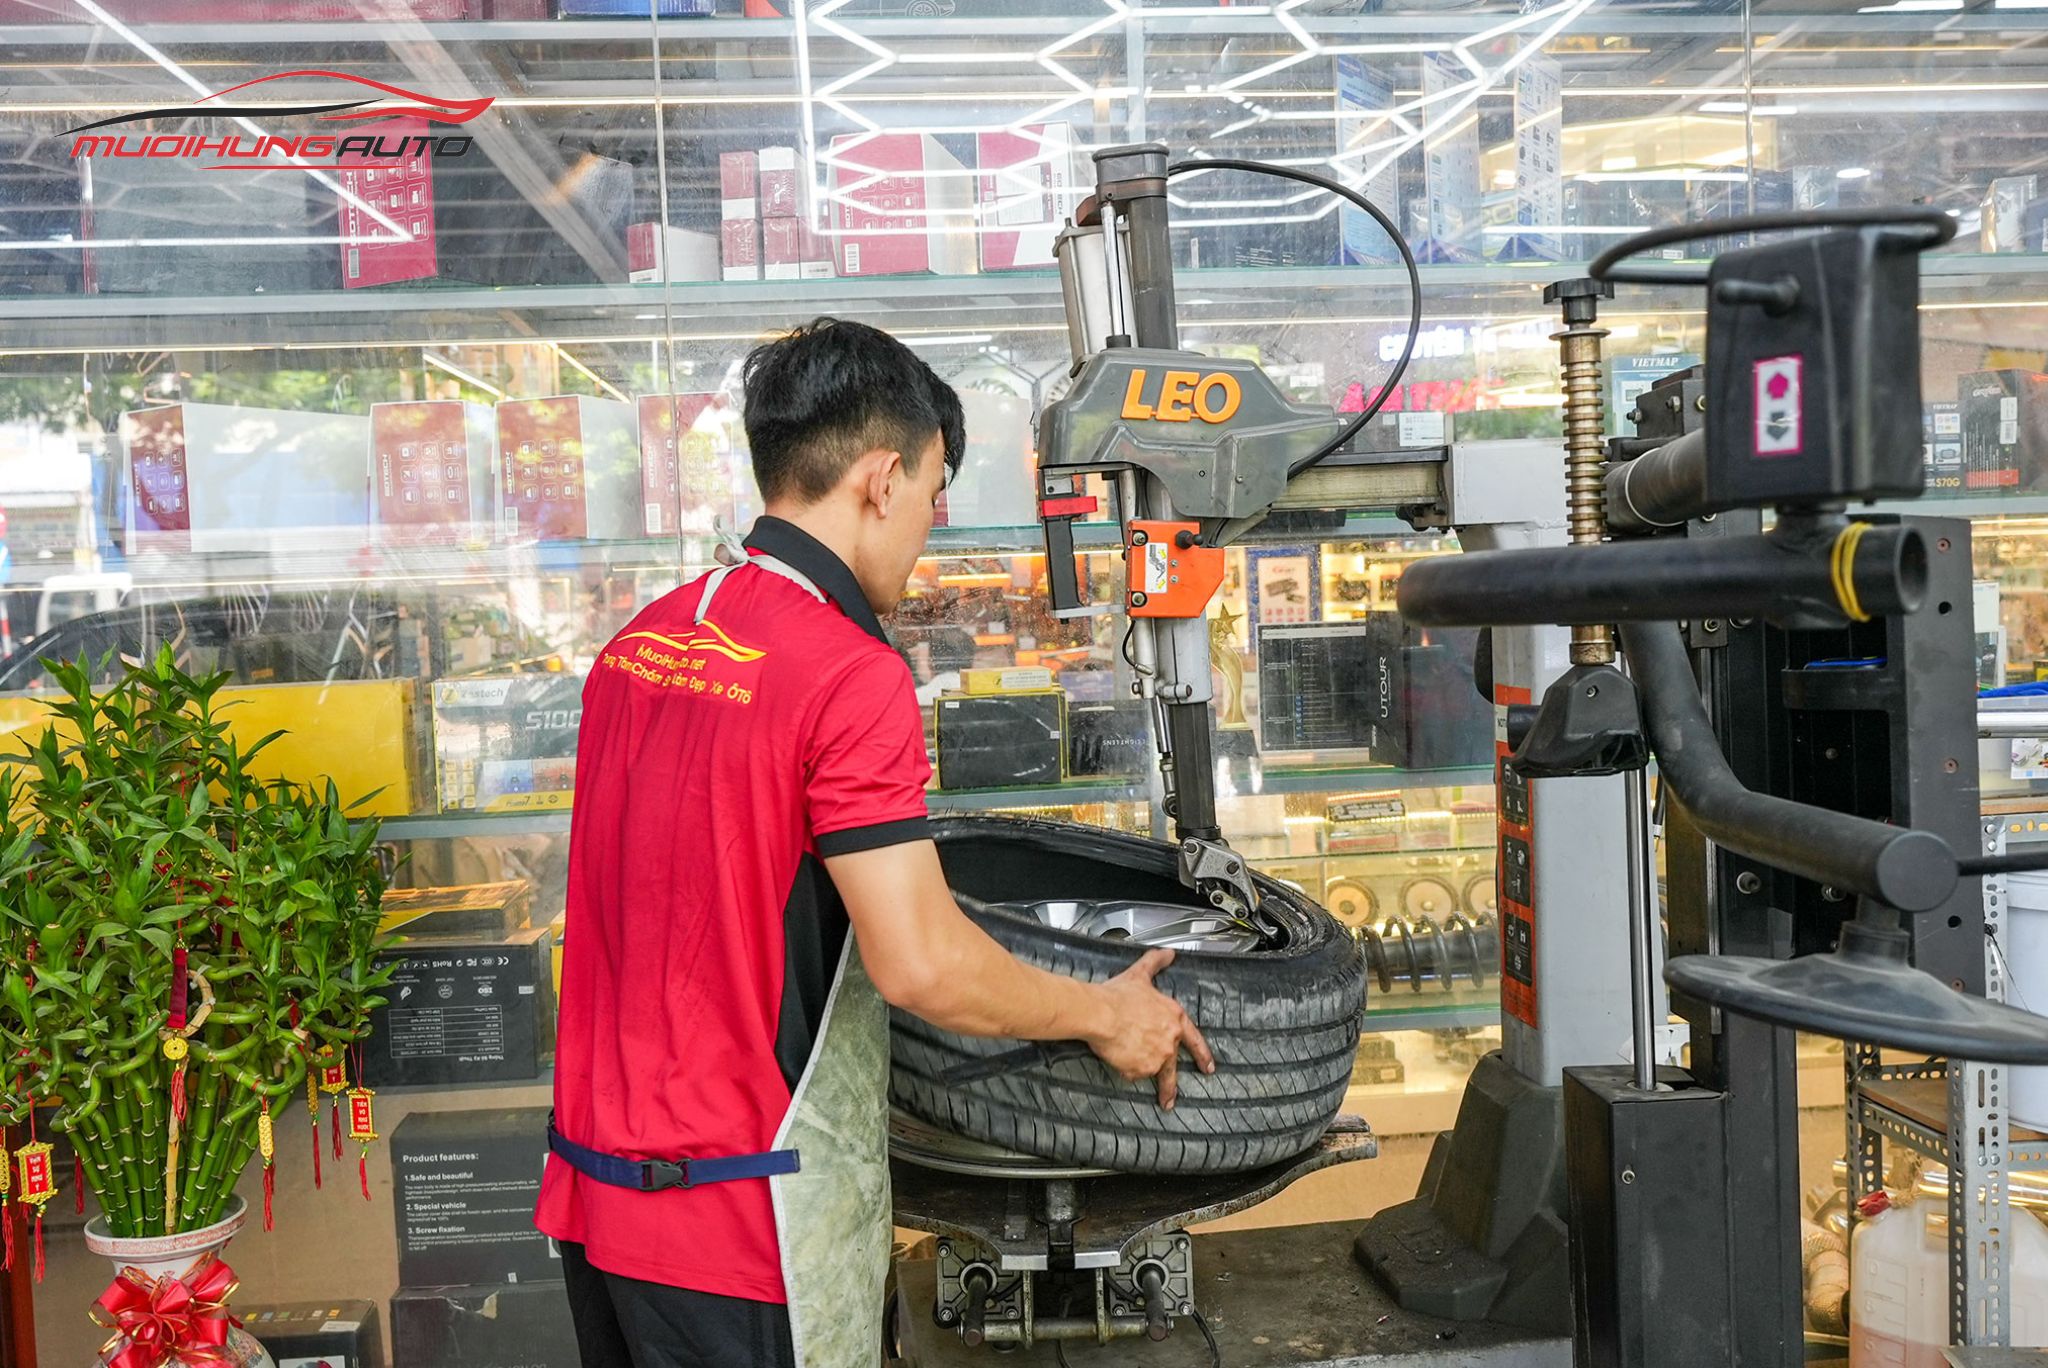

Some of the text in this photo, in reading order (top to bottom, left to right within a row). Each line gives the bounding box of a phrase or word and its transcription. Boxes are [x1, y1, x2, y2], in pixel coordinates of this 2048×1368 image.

[1631, 357, 1679, 368] VIETMAP
[1121, 369, 1242, 424] LEO
[709, 680, 724, 695] Xe
[1379, 656, 1388, 718] UTOUR
[432, 960, 453, 968] RoHS
[402, 1153, 479, 1163] Product features:
[404, 1172, 474, 1182] 1.Safe and beautiful
[406, 1201, 467, 1211] 2. Special vehicle
[408, 1225, 466, 1235] 3. Screw fixation
